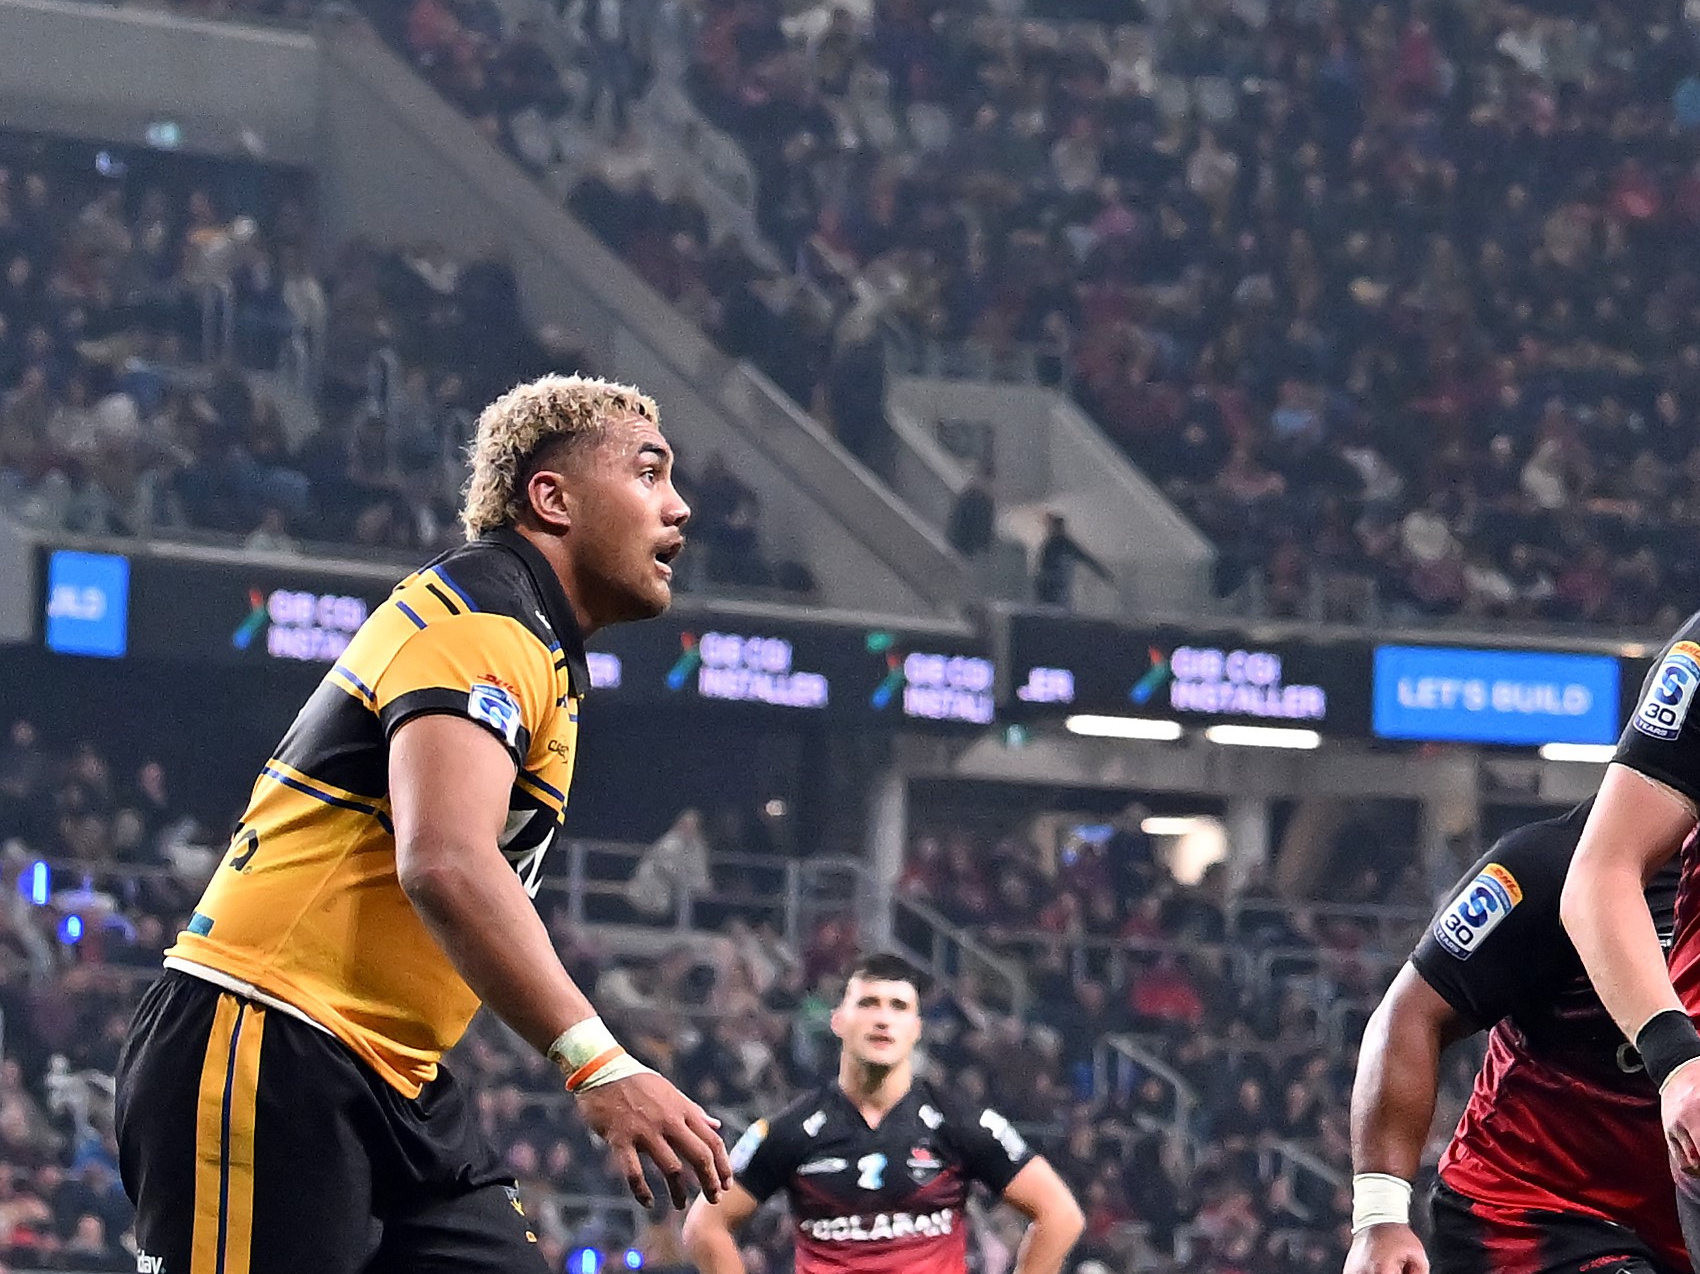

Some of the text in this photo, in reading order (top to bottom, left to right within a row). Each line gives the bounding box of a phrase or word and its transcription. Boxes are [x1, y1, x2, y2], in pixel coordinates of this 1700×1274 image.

[1397, 677, 1595, 716] LET'S BUILD
[1637, 718, 1668, 737] YEARS
[1643, 702, 1678, 726] 30
[1445, 914, 1475, 946] 30
